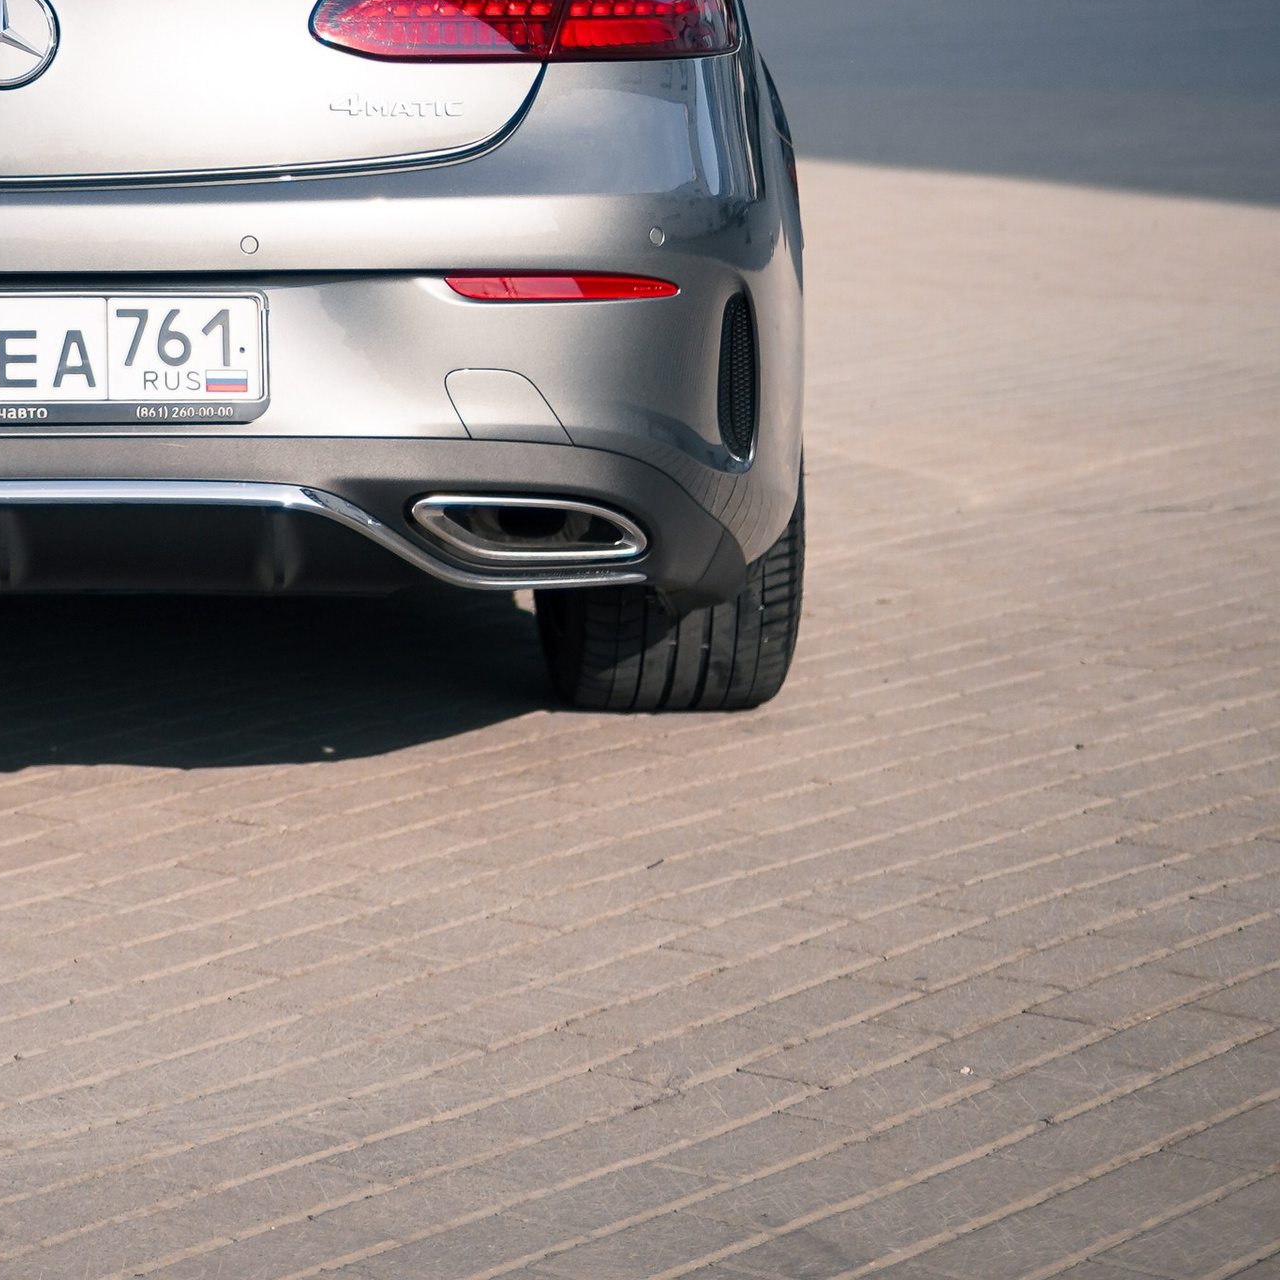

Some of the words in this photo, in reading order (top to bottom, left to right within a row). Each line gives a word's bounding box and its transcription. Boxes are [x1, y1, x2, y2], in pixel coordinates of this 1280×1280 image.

[329, 93, 463, 116] 4MATIC
[116, 308, 231, 366] 761
[143, 370, 201, 390] RUS
[136, 406, 168, 419] (861)
[171, 406, 234, 418] 260-00-00
